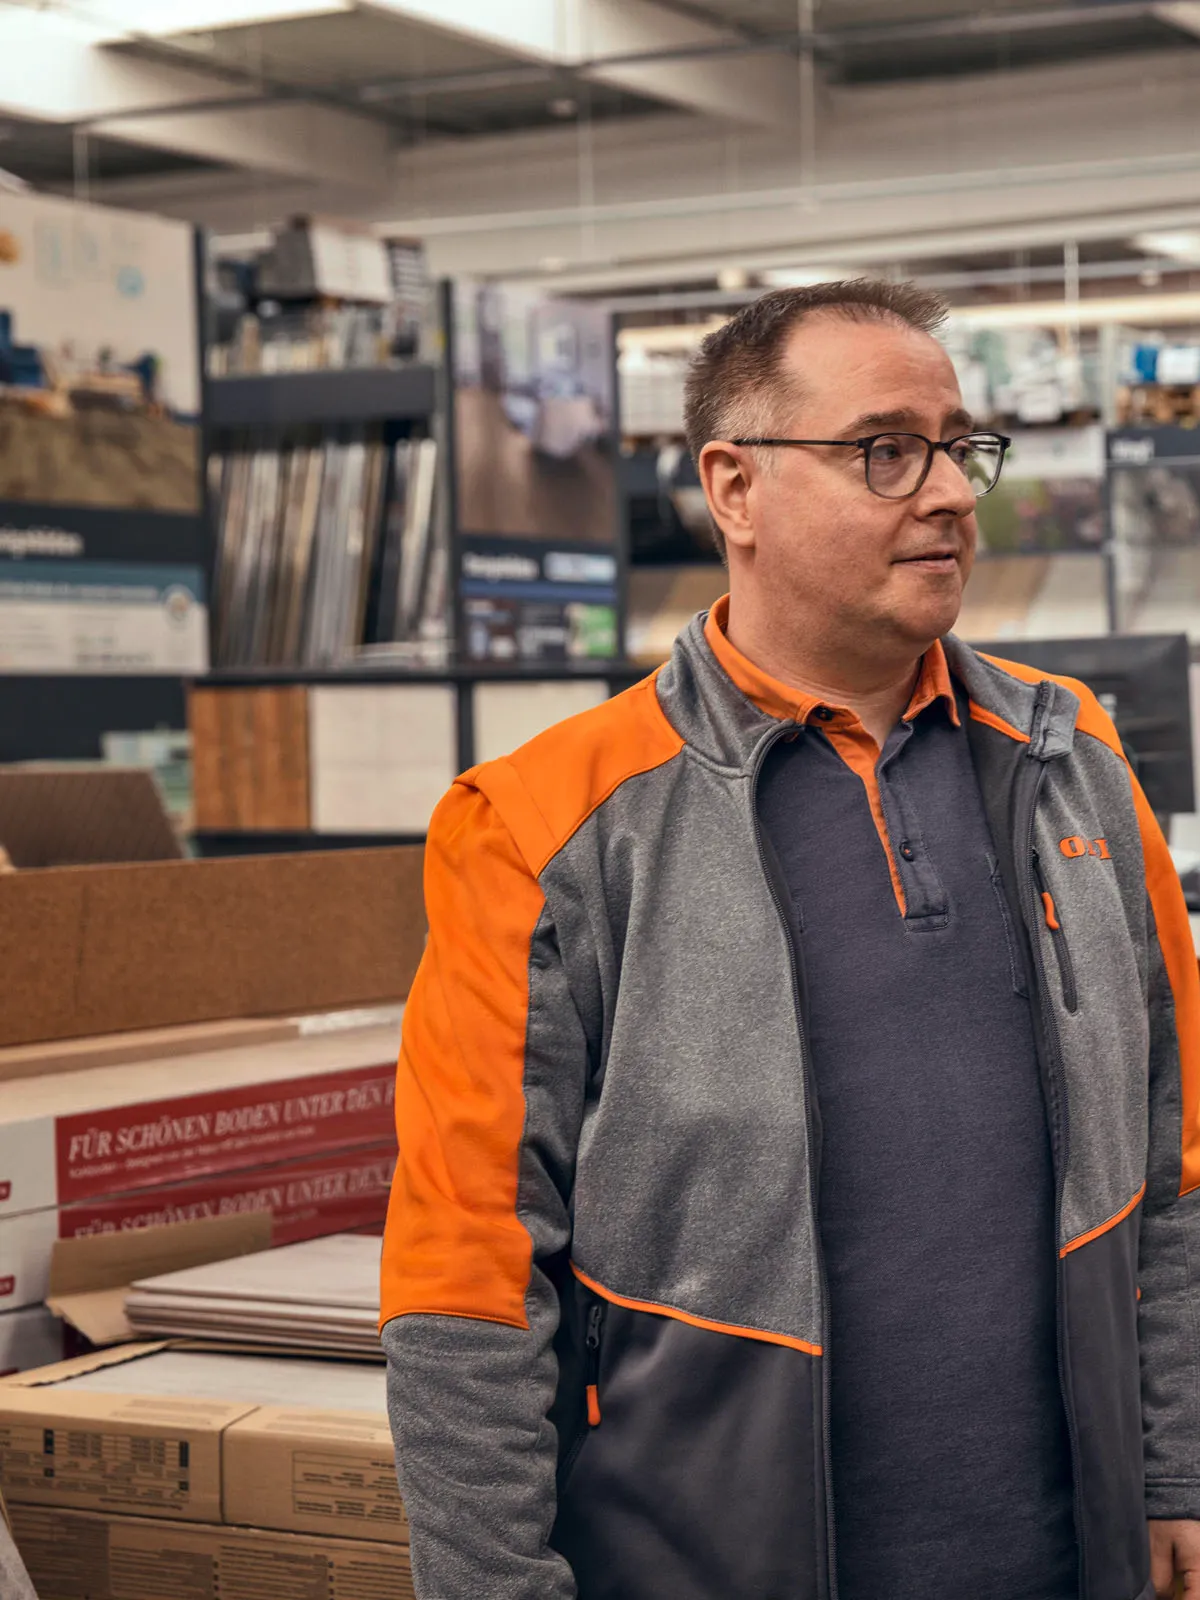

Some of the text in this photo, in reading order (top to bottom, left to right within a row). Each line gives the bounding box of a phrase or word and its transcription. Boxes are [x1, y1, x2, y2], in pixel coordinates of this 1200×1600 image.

[68, 1127, 112, 1163] FÜR
[115, 1113, 213, 1155] SCHÖNEN
[214, 1101, 283, 1137] BODEN
[283, 1090, 346, 1124] UNTER
[345, 1080, 386, 1113] DEN
[286, 1171, 348, 1208] UNTER
